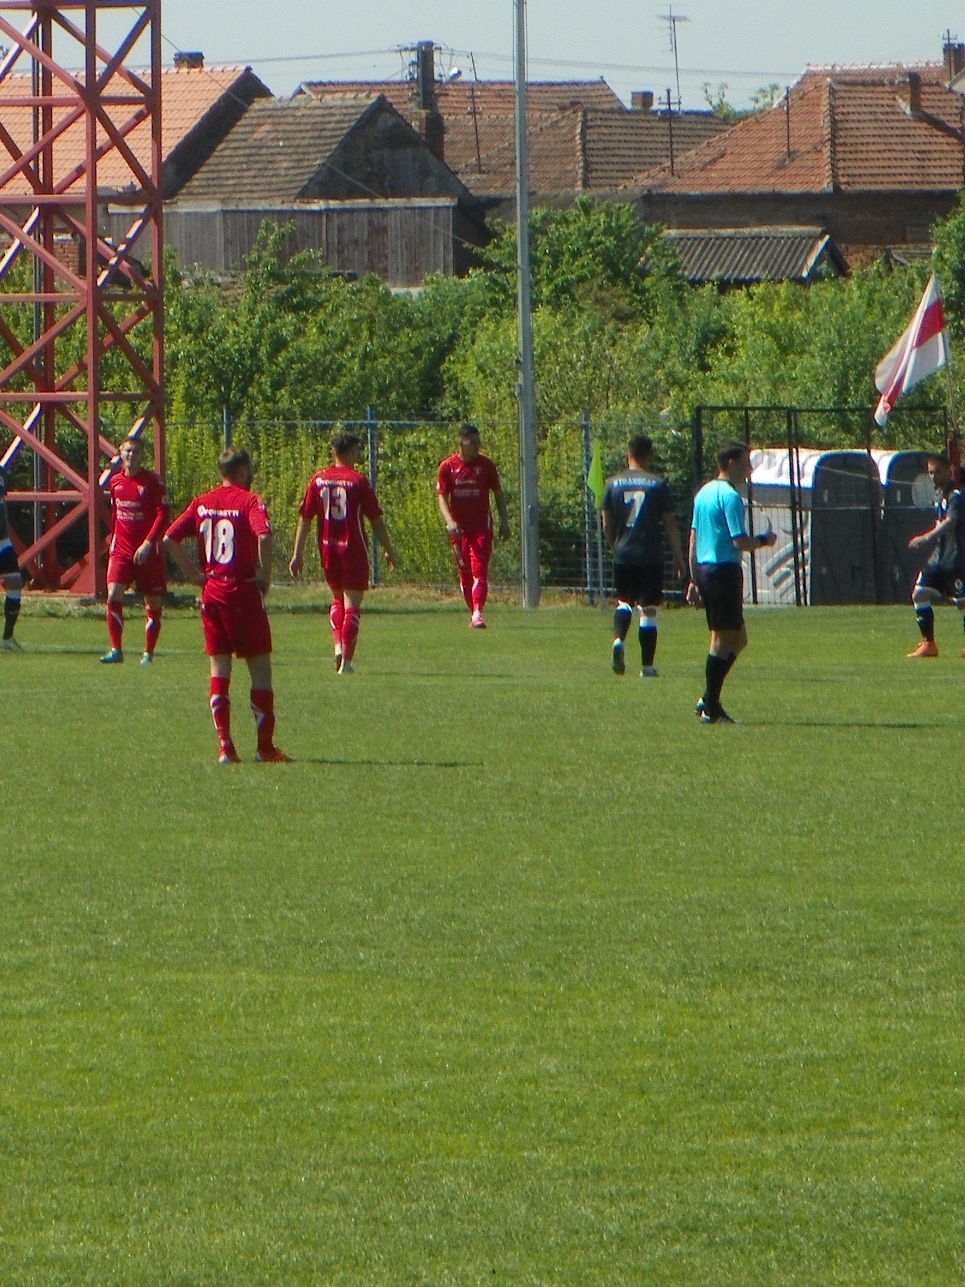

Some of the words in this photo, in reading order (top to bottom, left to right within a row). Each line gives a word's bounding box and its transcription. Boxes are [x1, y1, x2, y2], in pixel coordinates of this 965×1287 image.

[320, 486, 347, 520] 13
[623, 490, 646, 527] 7
[199, 518, 235, 565] 18
